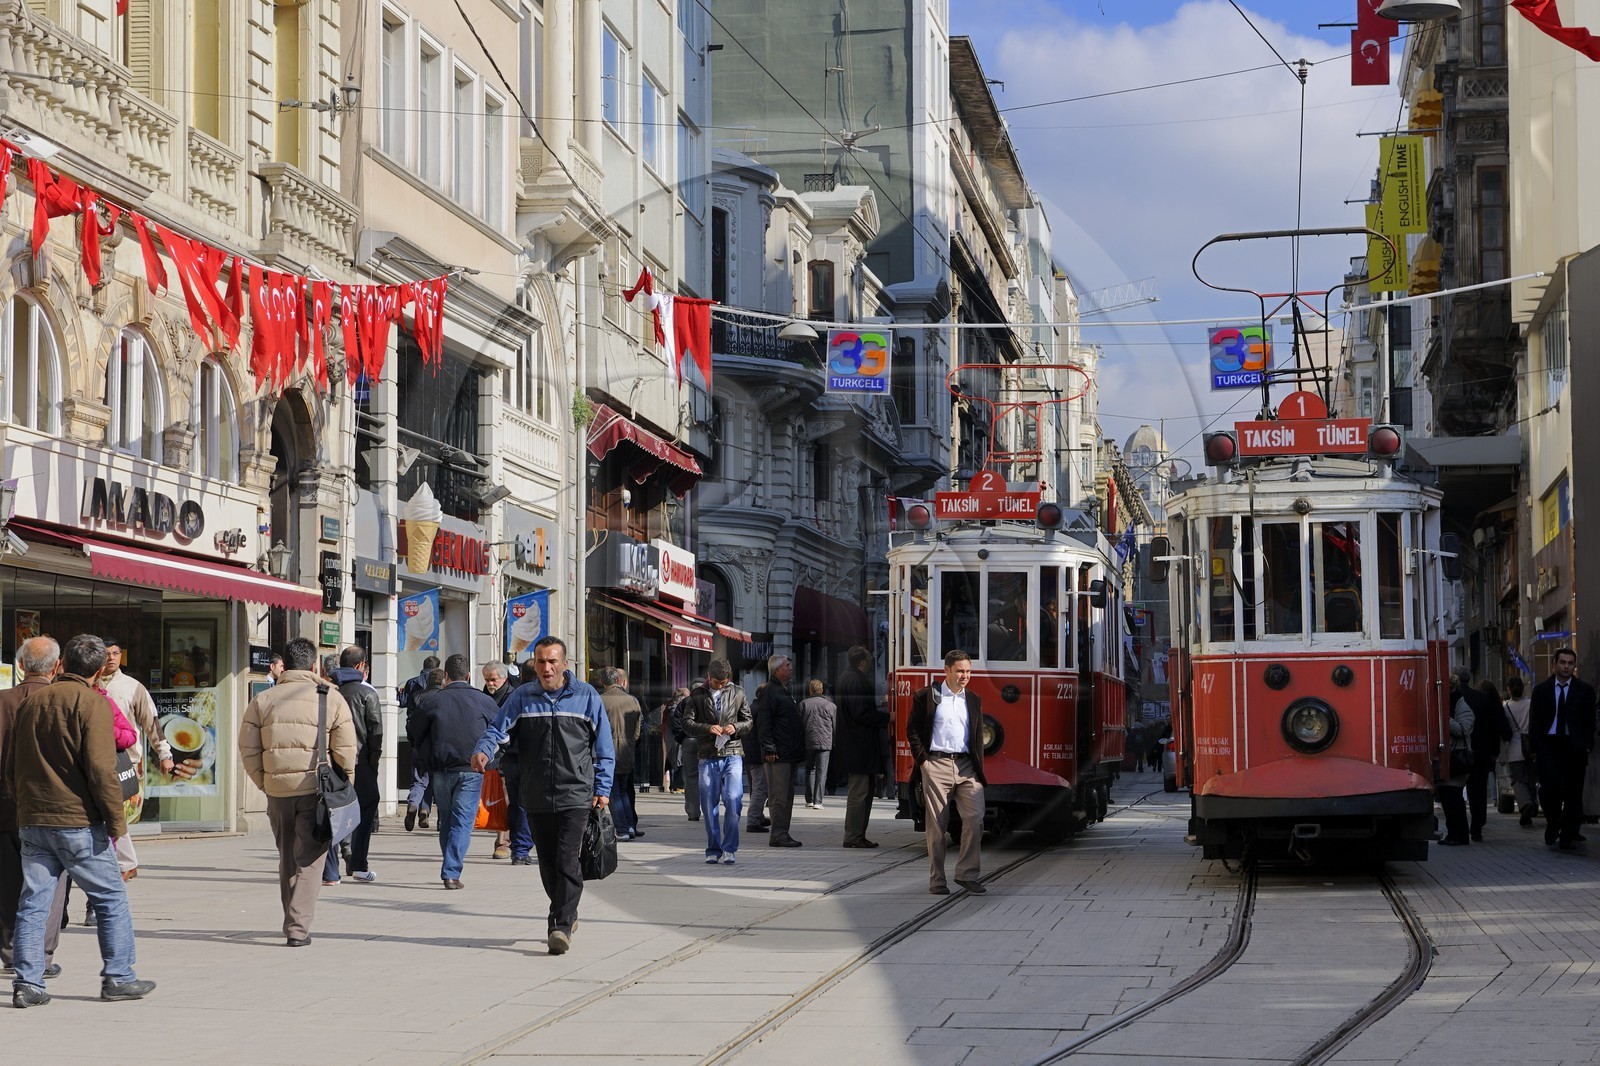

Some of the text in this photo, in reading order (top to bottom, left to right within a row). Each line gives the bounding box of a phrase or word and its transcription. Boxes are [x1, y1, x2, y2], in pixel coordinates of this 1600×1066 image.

[1397, 144, 1406, 170] TIME
[1399, 180, 1410, 227] ENGLISH
[1383, 242, 1393, 285] ENGLISH
[831, 332, 887, 376] 3G
[1212, 327, 1271, 373] 3G
[832, 378, 882, 388] TURKCELL
[1296, 396, 1305, 417] 1
[1244, 424, 1365, 448] TAKSİM TÜNEL
[982, 473, 993, 491] 2
[82, 477, 205, 539] MADO
[941, 496, 979, 513] TAKSİM
[998, 496, 1034, 512] TÜNEL
[223, 528, 247, 552] cafe
[432, 529, 490, 575] GER KING
[1057, 683, 1073, 699] 223
[1201, 673, 1215, 694] 47
[1399, 669, 1415, 690] 47
[158, 704, 180, 715] Doğal
